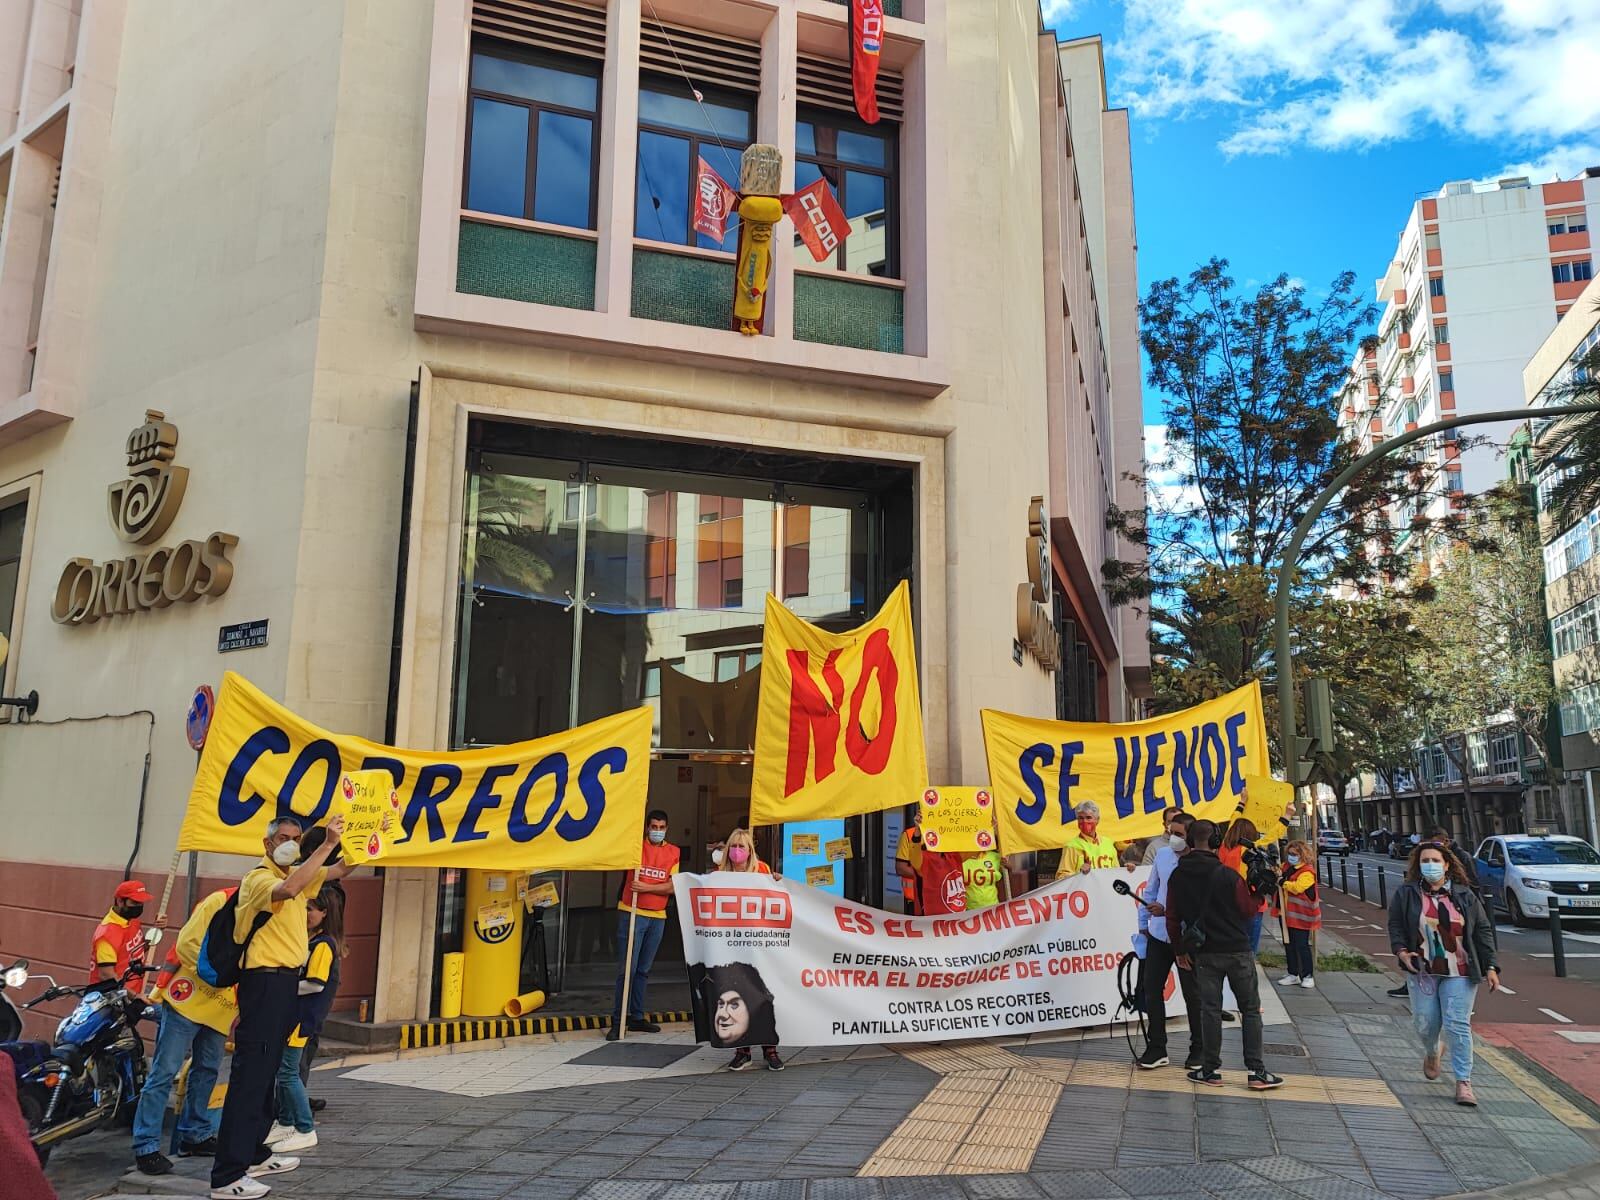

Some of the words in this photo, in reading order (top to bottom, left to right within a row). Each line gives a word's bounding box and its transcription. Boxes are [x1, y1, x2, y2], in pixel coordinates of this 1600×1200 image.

[800, 192, 838, 252] CCOO
[50, 531, 239, 627] CORREOS
[784, 628, 898, 798] NO
[1015, 740, 1084, 825] SE
[1114, 711, 1247, 820] VENDE
[927, 810, 935, 819] A
[937, 809, 952, 818] LOS
[953, 807, 983, 818] CIERRES
[944, 797, 963, 807] NO
[697, 894, 787, 920] CCOO
[834, 906, 876, 936] ES
[883, 918, 924, 938] EL
[932, 890, 1090, 938] MOMENTO
[725, 930, 731, 938] a
[733, 929, 742, 938] la
[744, 929, 791, 939] ciudadanía
[727, 939, 763, 947] correos
[765, 939, 790, 949] postal
[833, 953, 851, 964] EN
[855, 954, 917, 967] DEFENSA
[919, 957, 942, 967] DEL
[945, 951, 1000, 968] SERVICIO
[1003, 943, 1044, 960] POSTAL
[1048, 938, 1097, 953] PÚBLICO
[801, 968, 880, 988] CONTRA
[886, 971, 910, 988] EL
[916, 963, 1010, 988] DESGUACE
[1016, 960, 1043, 979] DE
[1048, 951, 1124, 976] CORREOS
[832, 1020, 909, 1035] PLANTILLA
[911, 1014, 990, 1033] SUFICIENTE
[992, 1014, 1001, 1027] Y
[1005, 1010, 1034, 1026] CON
[1038, 1002, 1107, 1022] DERECHOS
[888, 1001, 943, 1015] CONTRA
[946, 998, 973, 1012] LOS
[977, 991, 1054, 1010] RECORTES,
